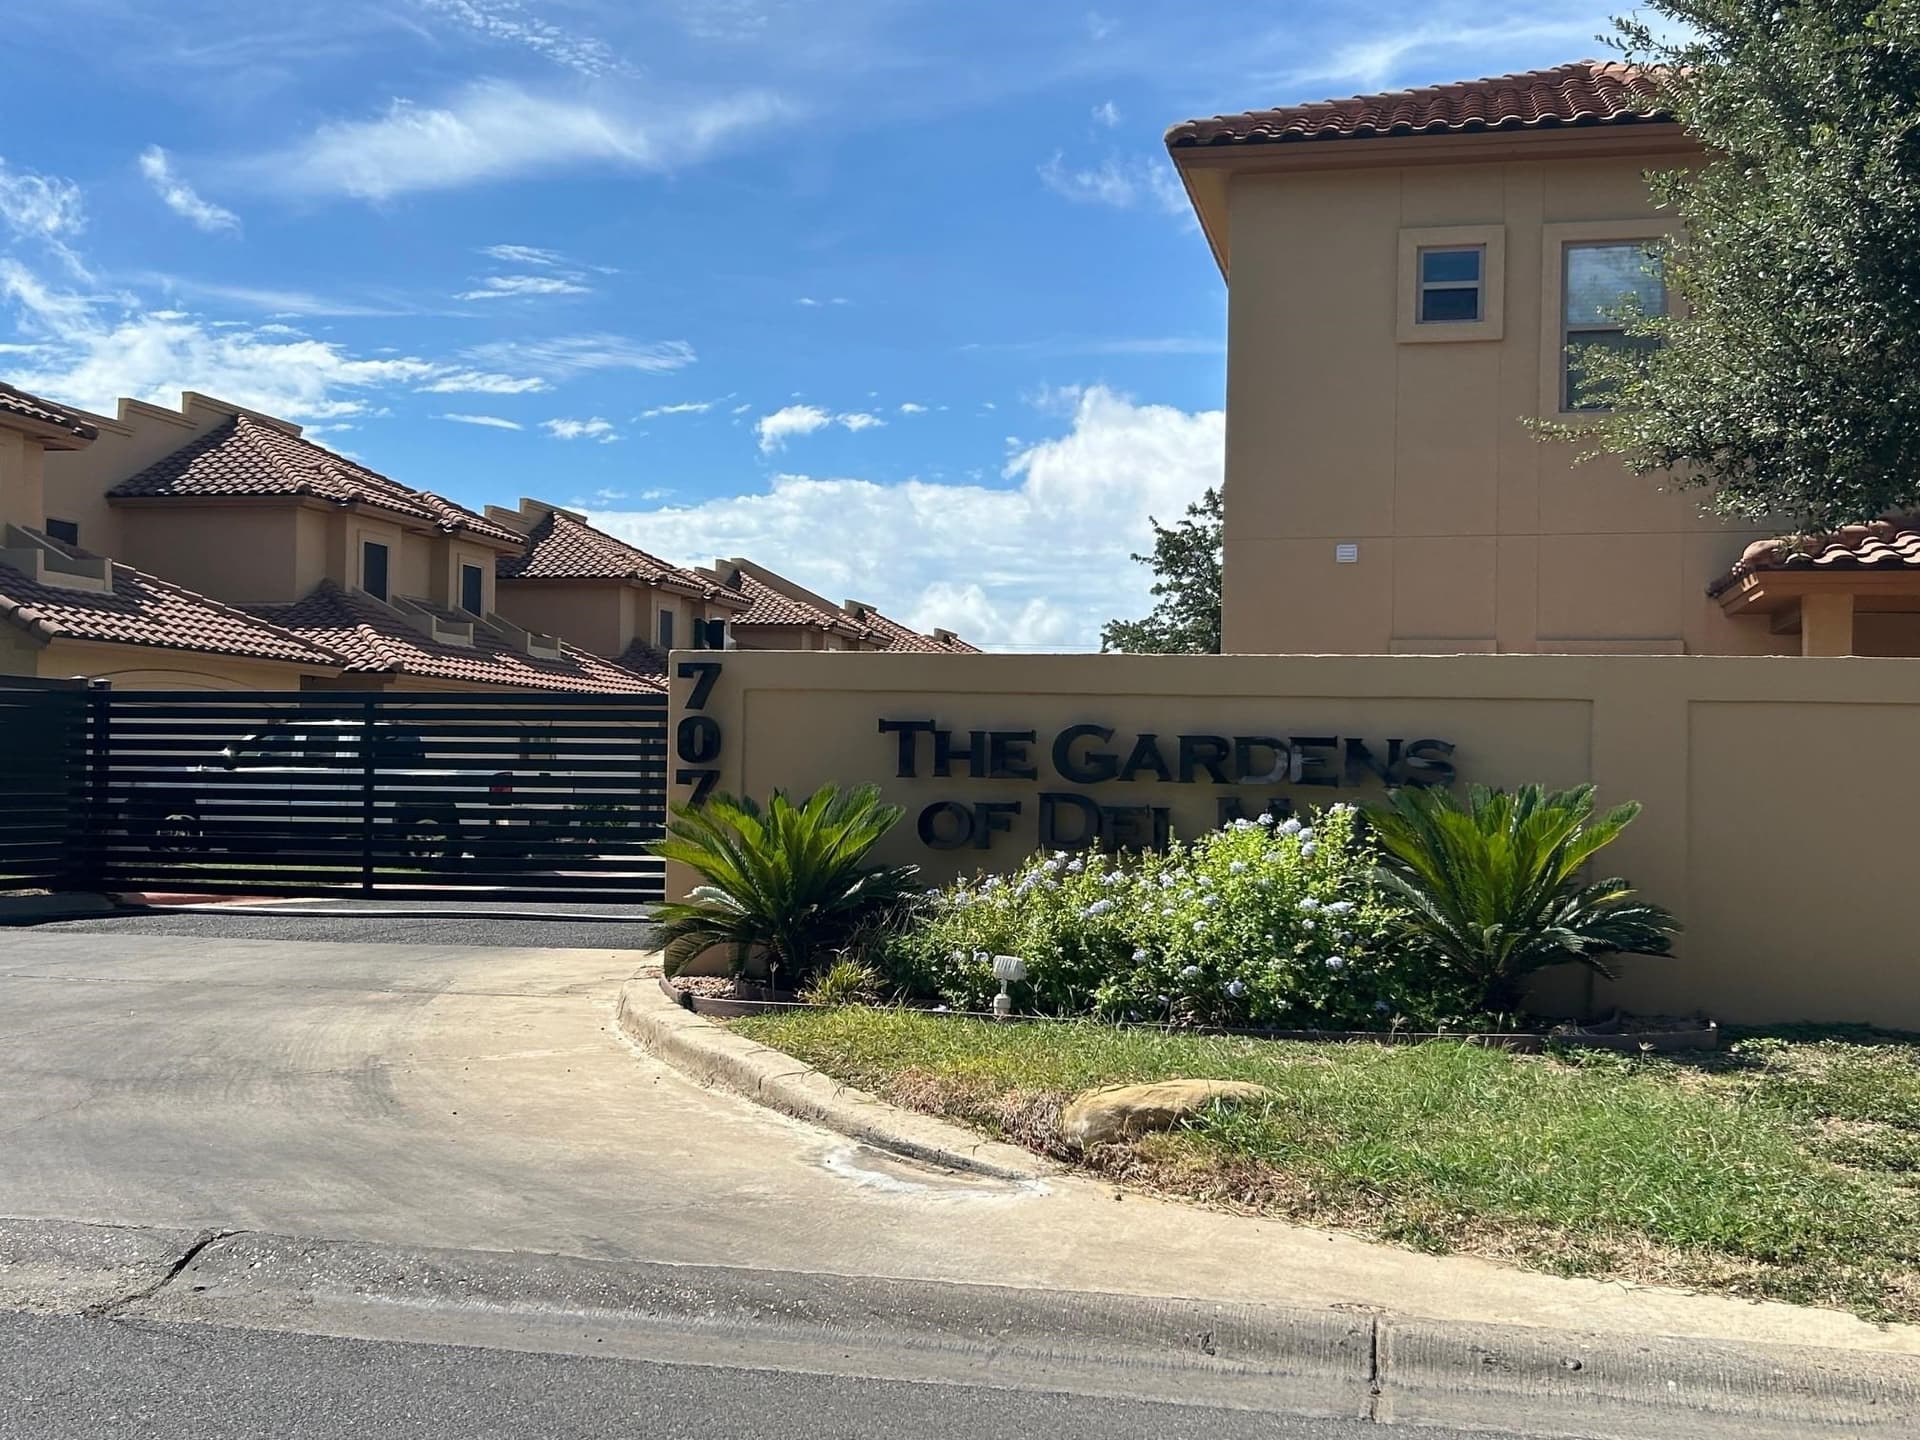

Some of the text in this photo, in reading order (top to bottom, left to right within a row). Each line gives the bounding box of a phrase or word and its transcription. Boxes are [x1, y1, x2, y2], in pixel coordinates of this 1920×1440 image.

[676, 663, 722, 810] 707
[878, 718, 1457, 788] THE GARDENS
[917, 800, 1021, 850] OF
